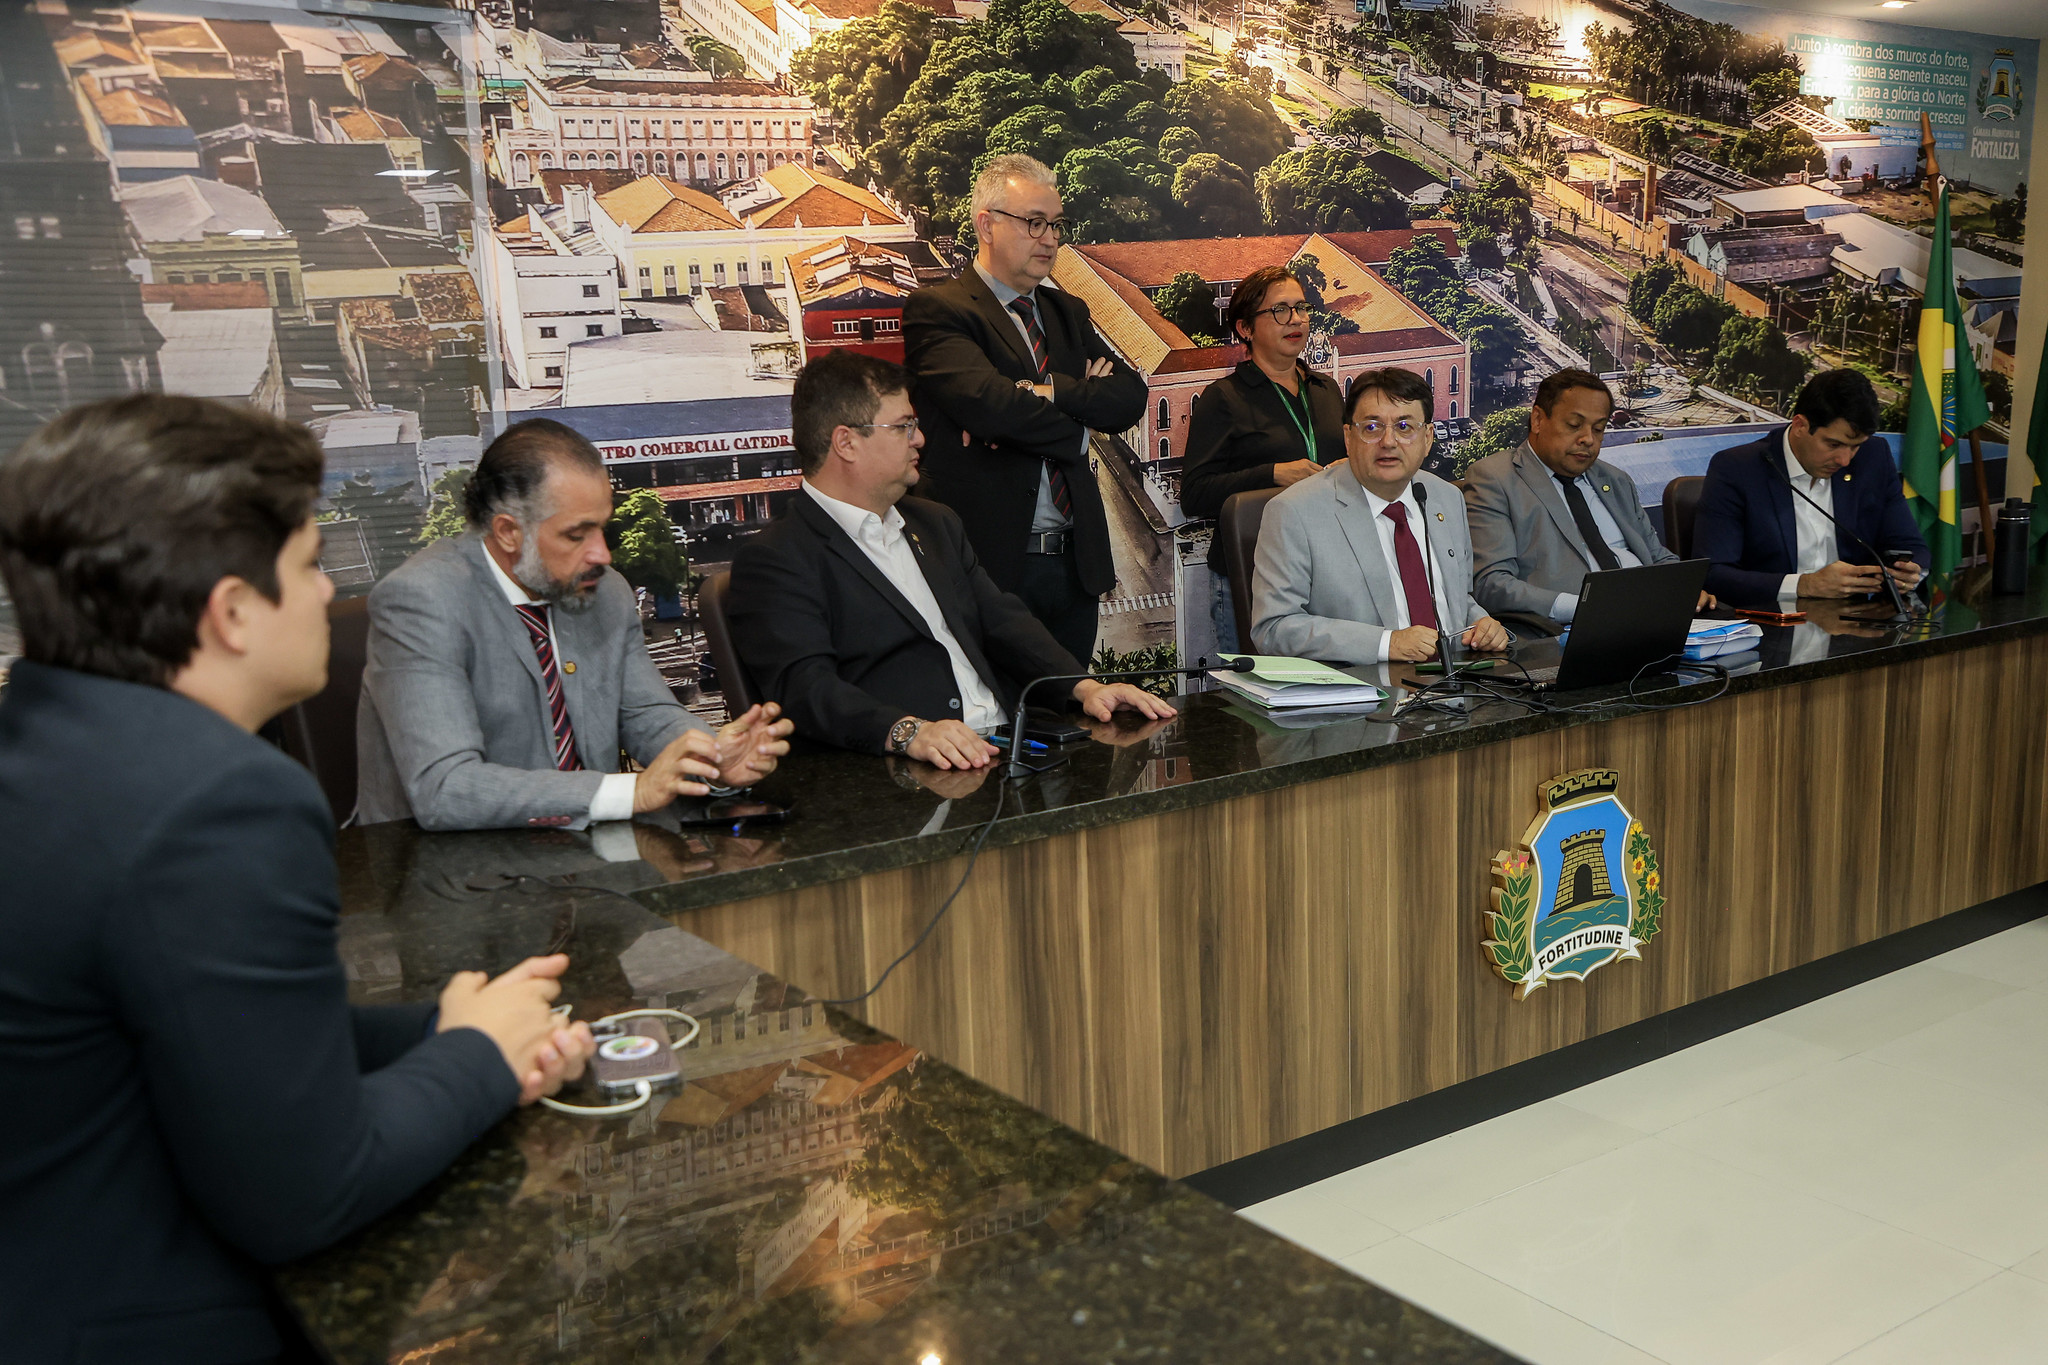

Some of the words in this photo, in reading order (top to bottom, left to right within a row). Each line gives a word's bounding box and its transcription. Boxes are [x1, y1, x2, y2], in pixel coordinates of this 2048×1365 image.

[1791, 35, 1821, 53] Junto
[1832, 42, 1873, 59] sombra
[1875, 44, 1894, 61] dos
[1897, 49, 1927, 64] muros
[1930, 50, 1942, 65] do
[1945, 51, 1970, 71] forte,
[1842, 63, 1887, 80] pequena
[1889, 68, 1931, 83] semente
[1933, 73, 1968, 87] nasceu.
[1857, 85, 1881, 101] para
[1883, 88, 1889, 100] a
[1892, 85, 1920, 103] glória
[1922, 88, 1935, 104] do
[1937, 90, 1967, 109] Norte,
[1837, 101, 1846, 116] A
[1848, 102, 1884, 119] cidade
[1885, 106, 1926, 121] sorrind
[1929, 111, 1965, 125] cresceu
[1971, 137, 2020, 160] FORTALEZA
[599, 445, 636, 459] TRO
[641, 438, 730, 457] COMERCIAL
[734, 434, 795, 450] CATEDR
[1538, 929, 1624, 971] FORTITUDINE
